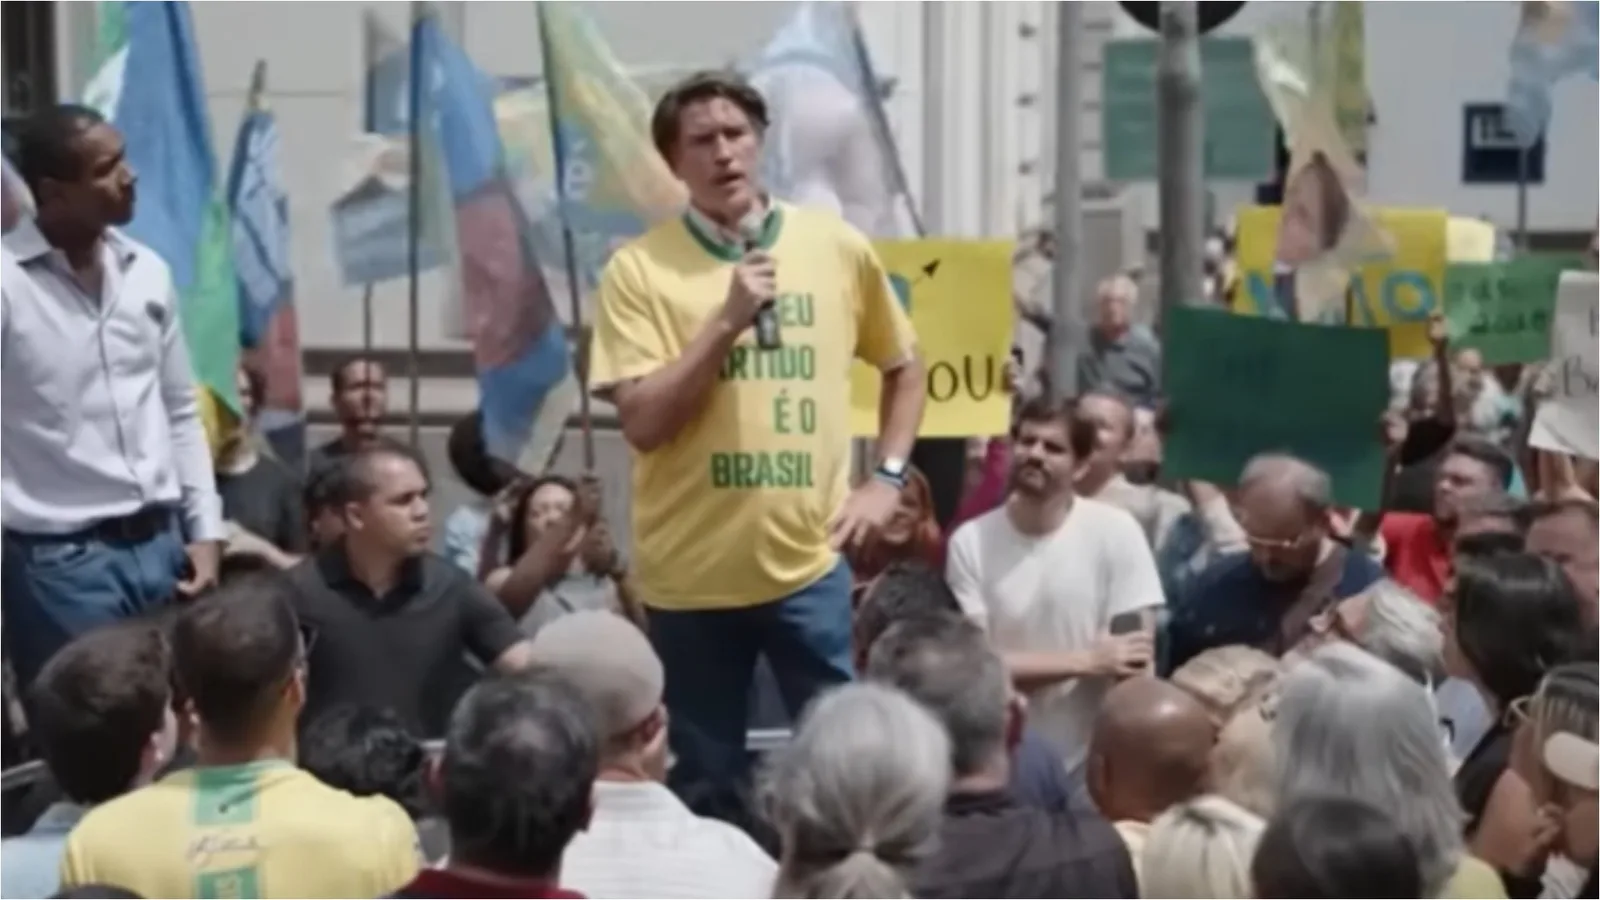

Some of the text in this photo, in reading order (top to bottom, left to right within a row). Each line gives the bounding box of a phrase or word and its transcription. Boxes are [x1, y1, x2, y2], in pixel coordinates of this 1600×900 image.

[778, 292, 815, 328] EU
[719, 345, 816, 381] RTIDO
[774, 387, 816, 434] É O
[711, 450, 814, 489] BRASIL
